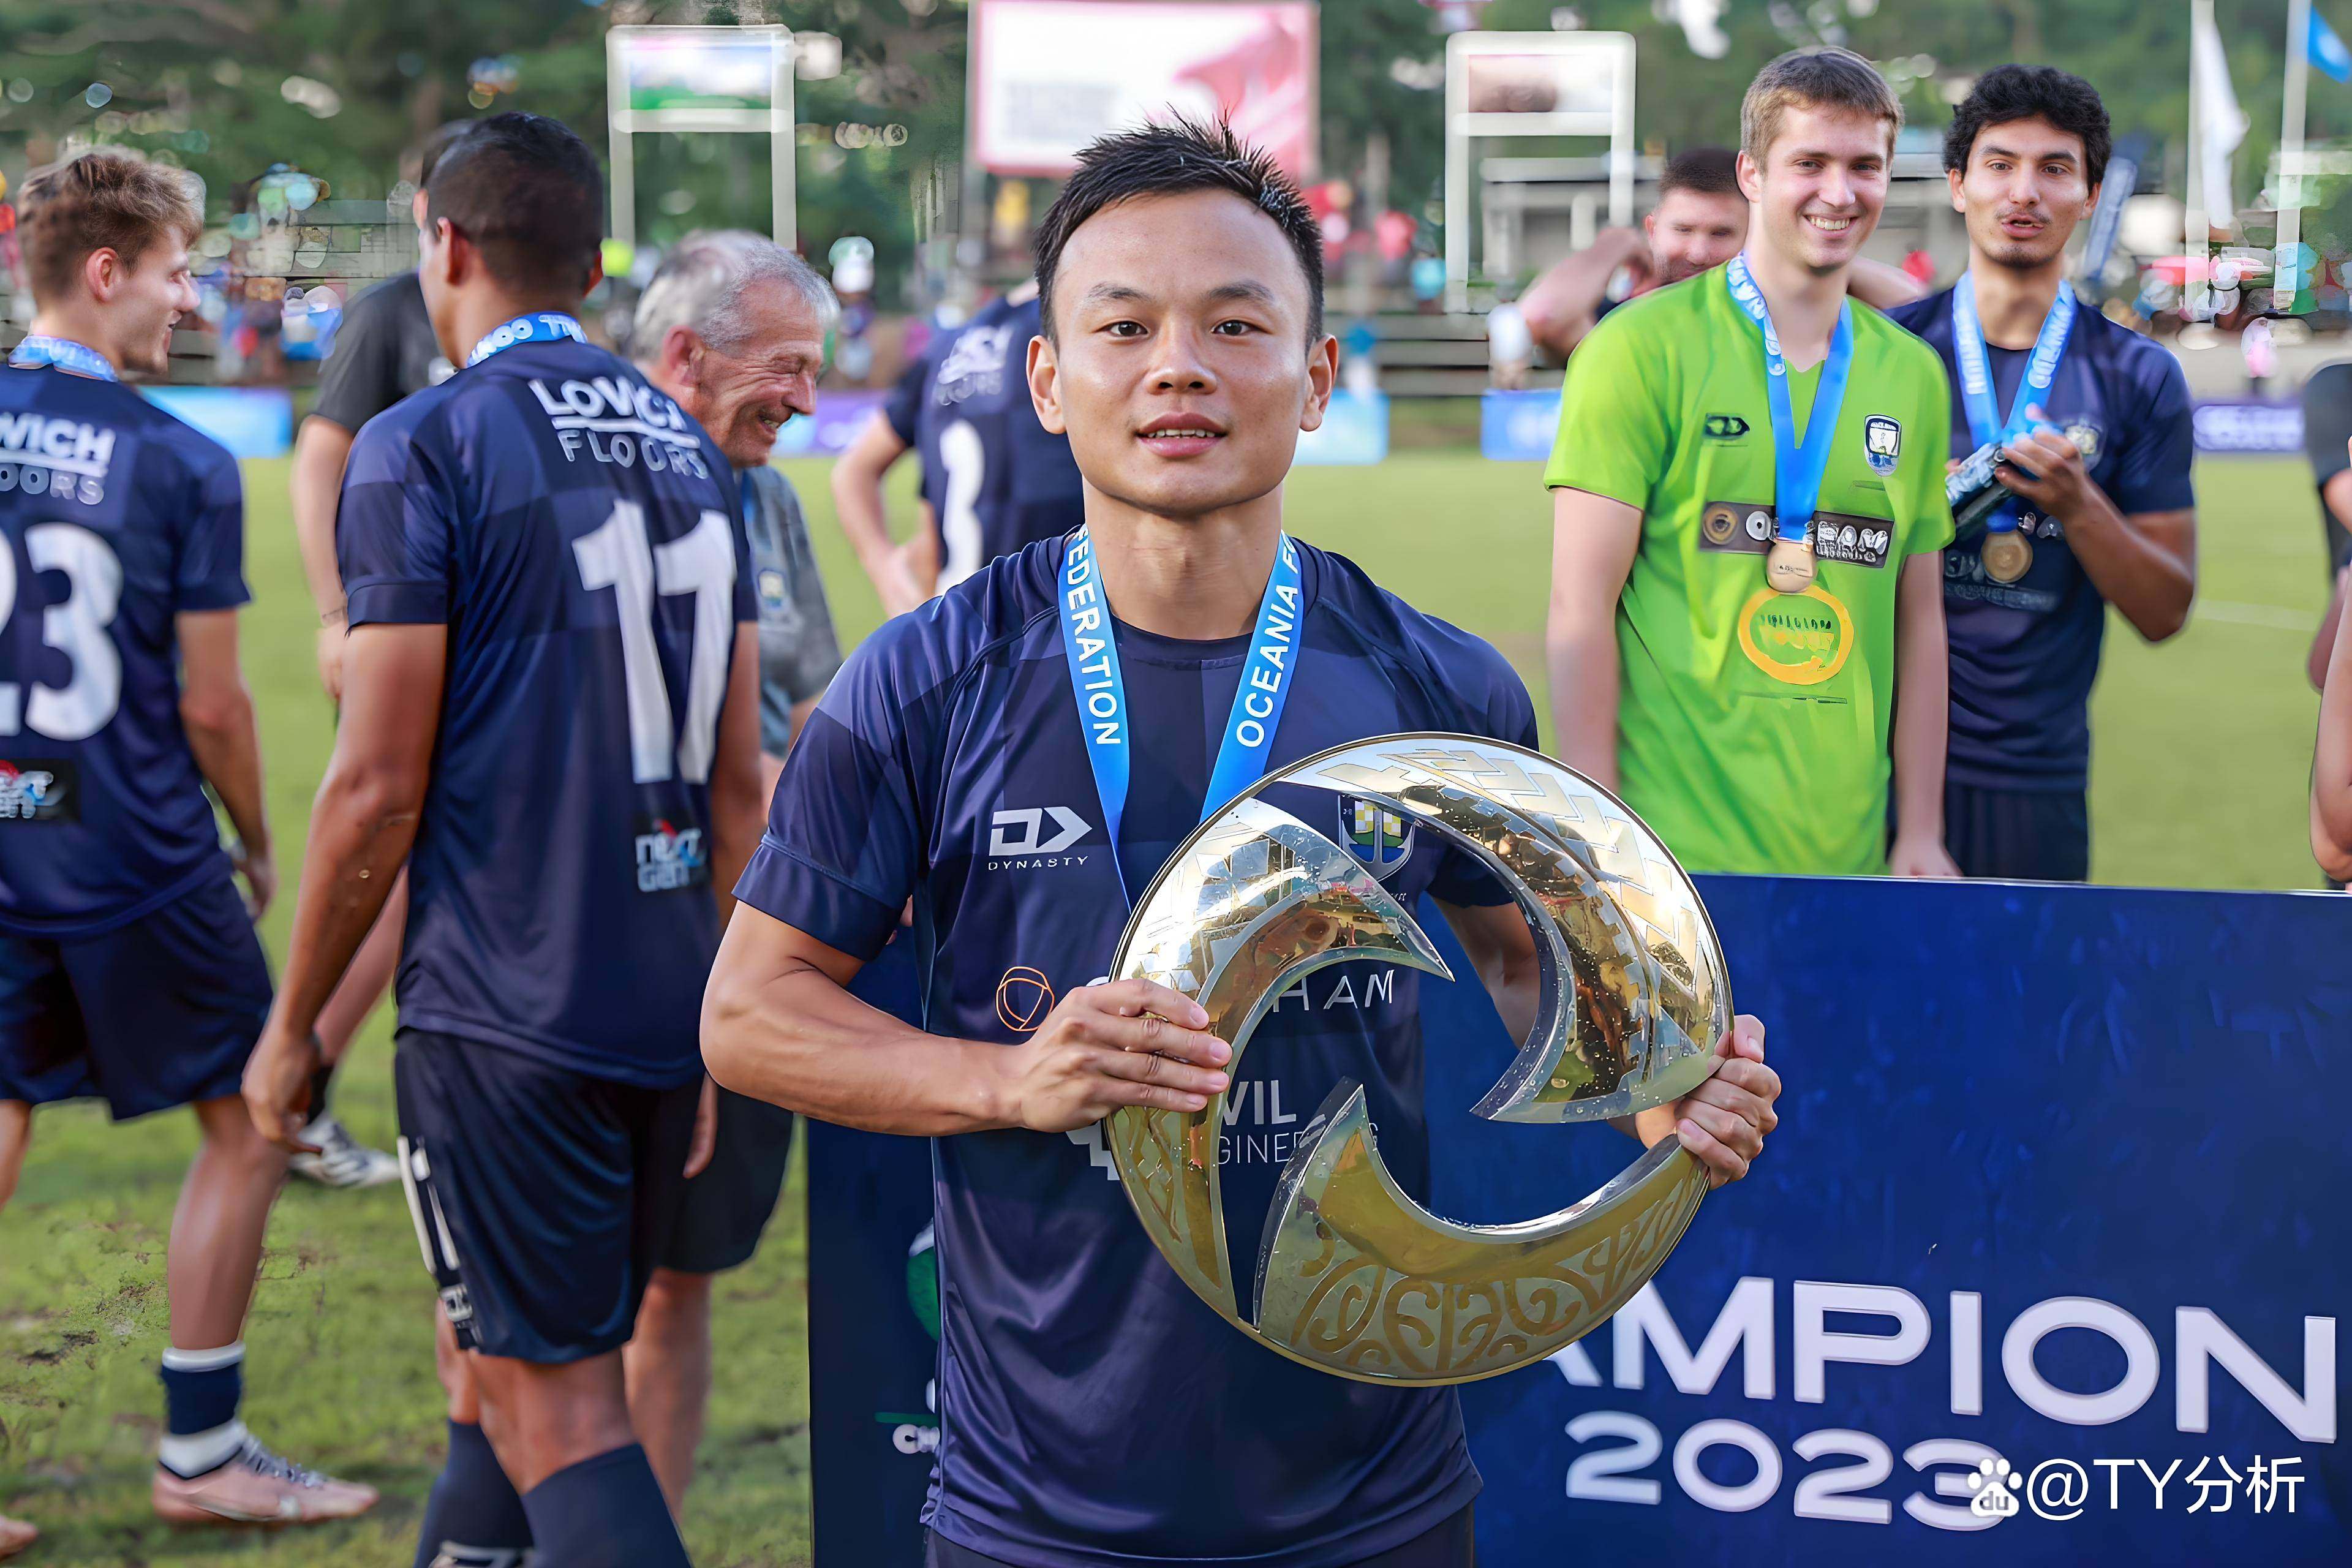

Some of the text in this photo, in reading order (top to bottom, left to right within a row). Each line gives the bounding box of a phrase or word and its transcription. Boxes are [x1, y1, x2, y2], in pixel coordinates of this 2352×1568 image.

[557, 429, 709, 480] FLOORS
[0, 521, 124, 742] 3
[571, 499, 736, 785] 11
[1067, 522, 1121, 744] FEDERATION
[1236, 585, 1298, 748] OCEANIA
[988, 856, 1088, 871] DYNASTY
[1565, 1412, 2009, 1532] 2023
